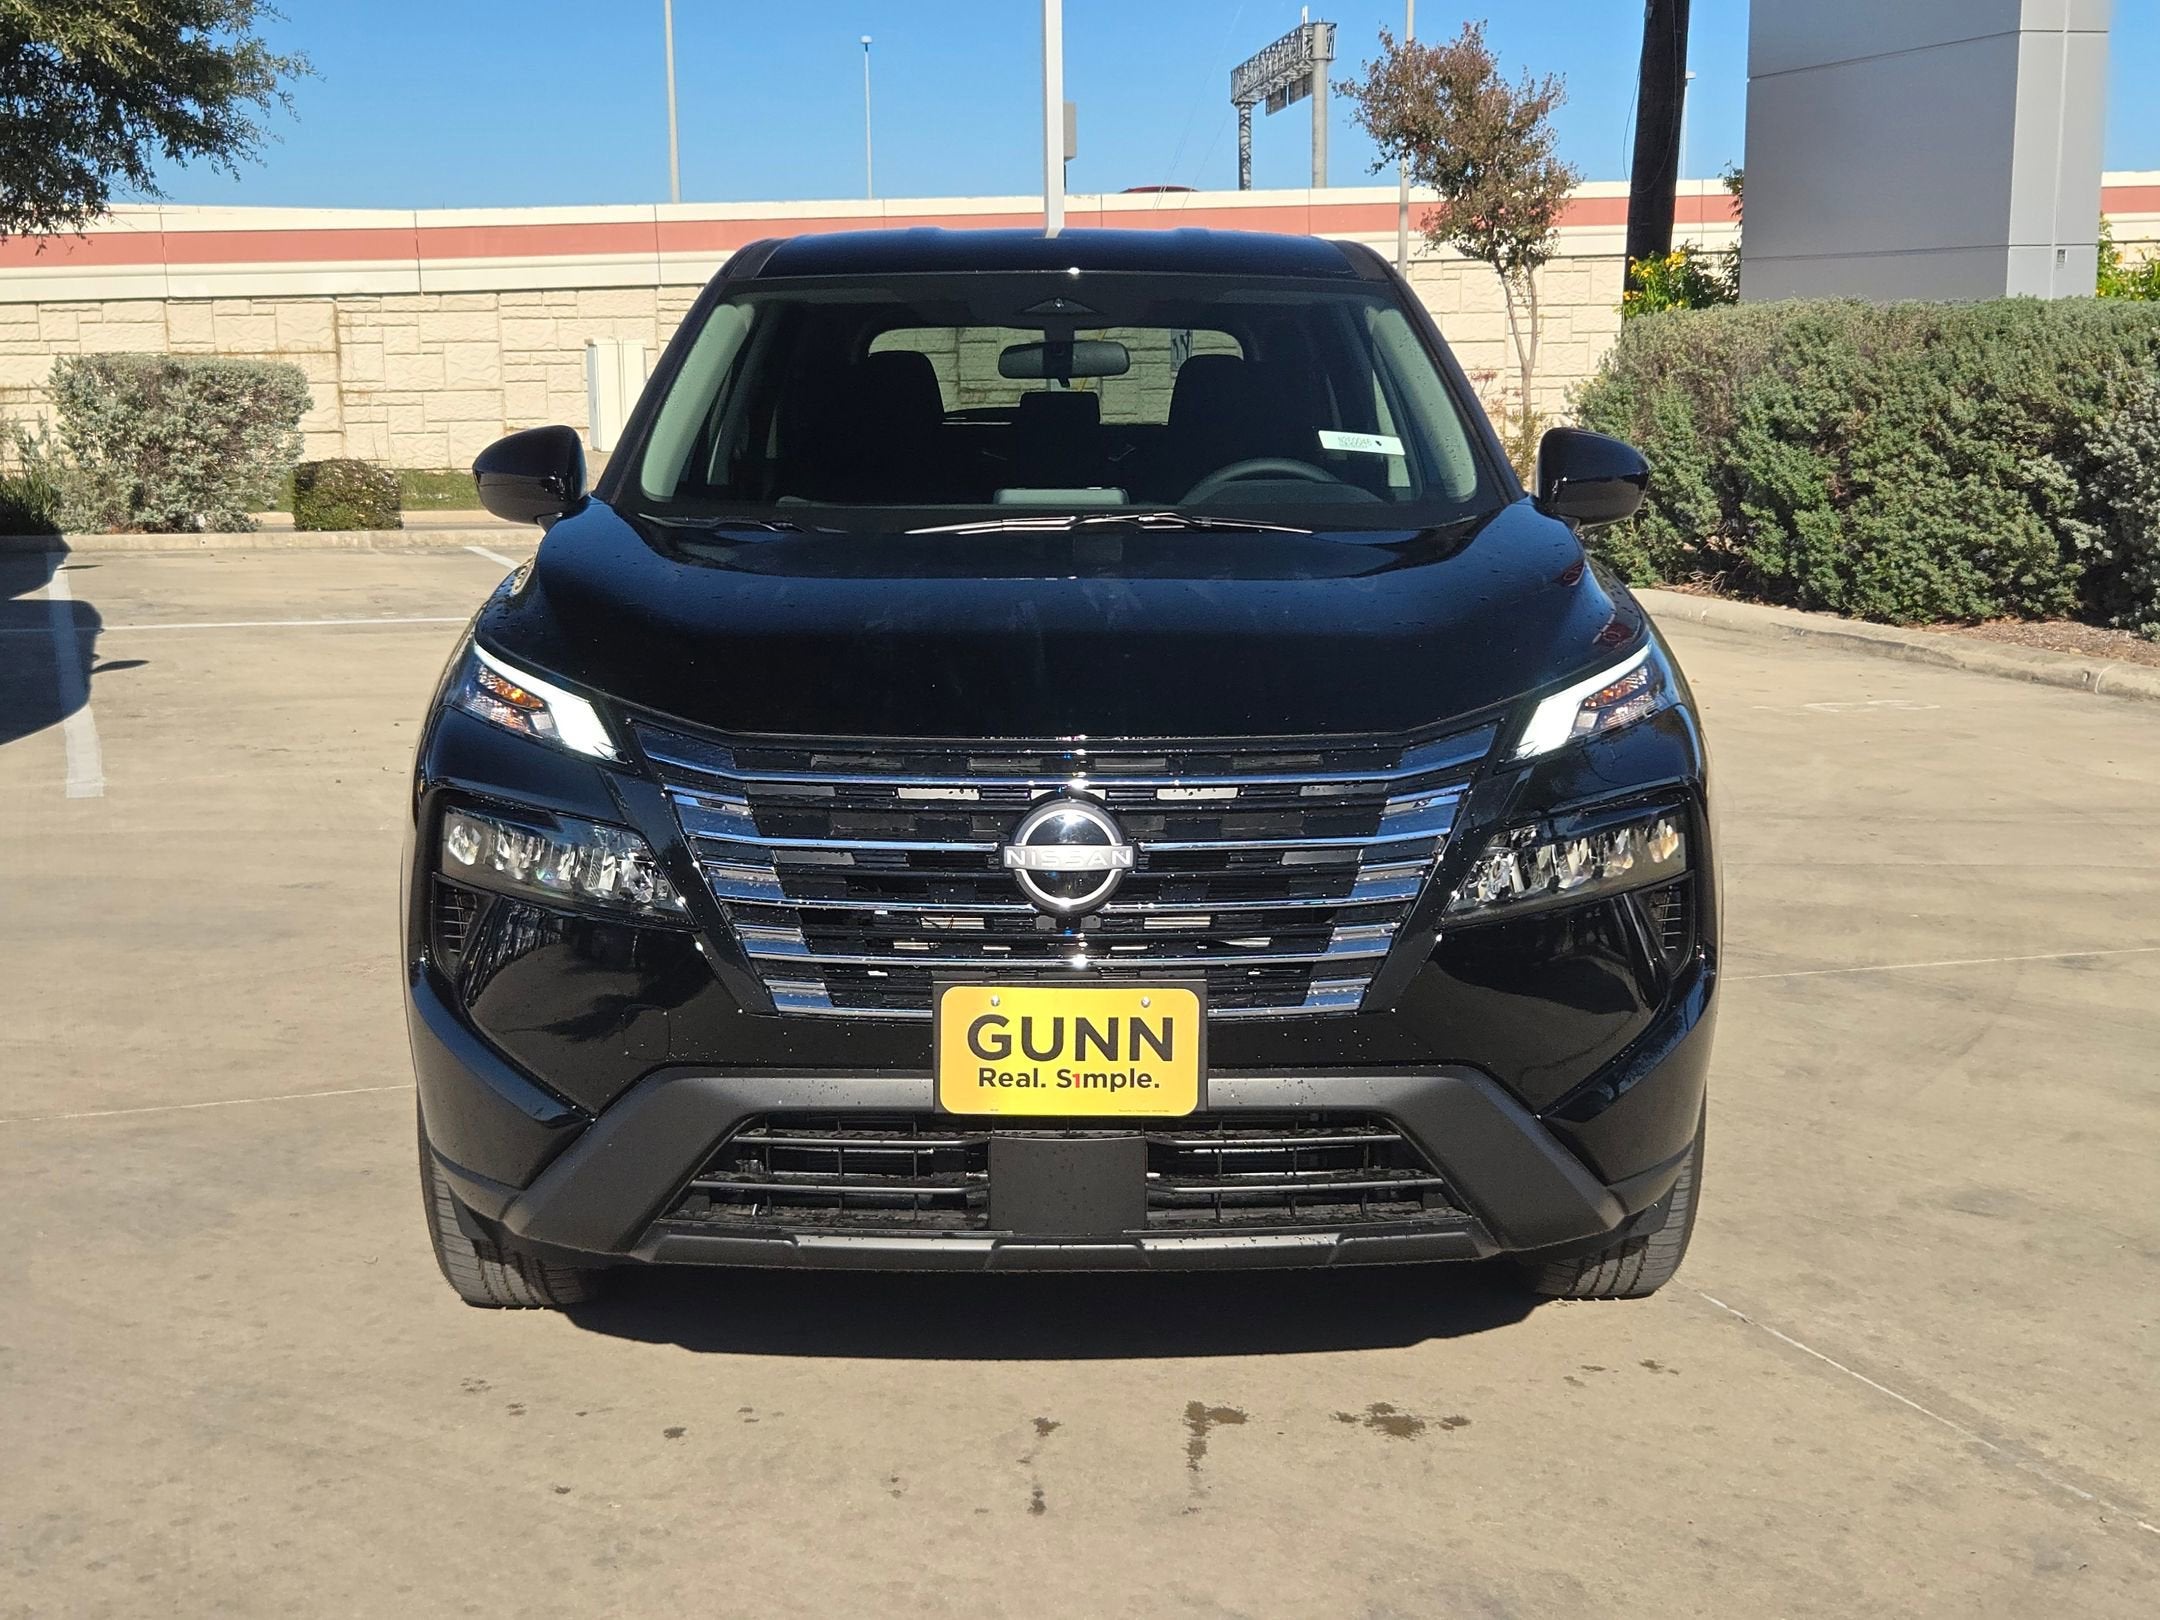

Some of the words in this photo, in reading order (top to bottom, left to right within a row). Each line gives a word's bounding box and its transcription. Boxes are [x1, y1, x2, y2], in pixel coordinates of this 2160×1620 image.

[1005, 849, 1131, 866] NISSAN
[967, 1013, 1173, 1062] GUNN
[978, 1067, 1047, 1088] Real.
